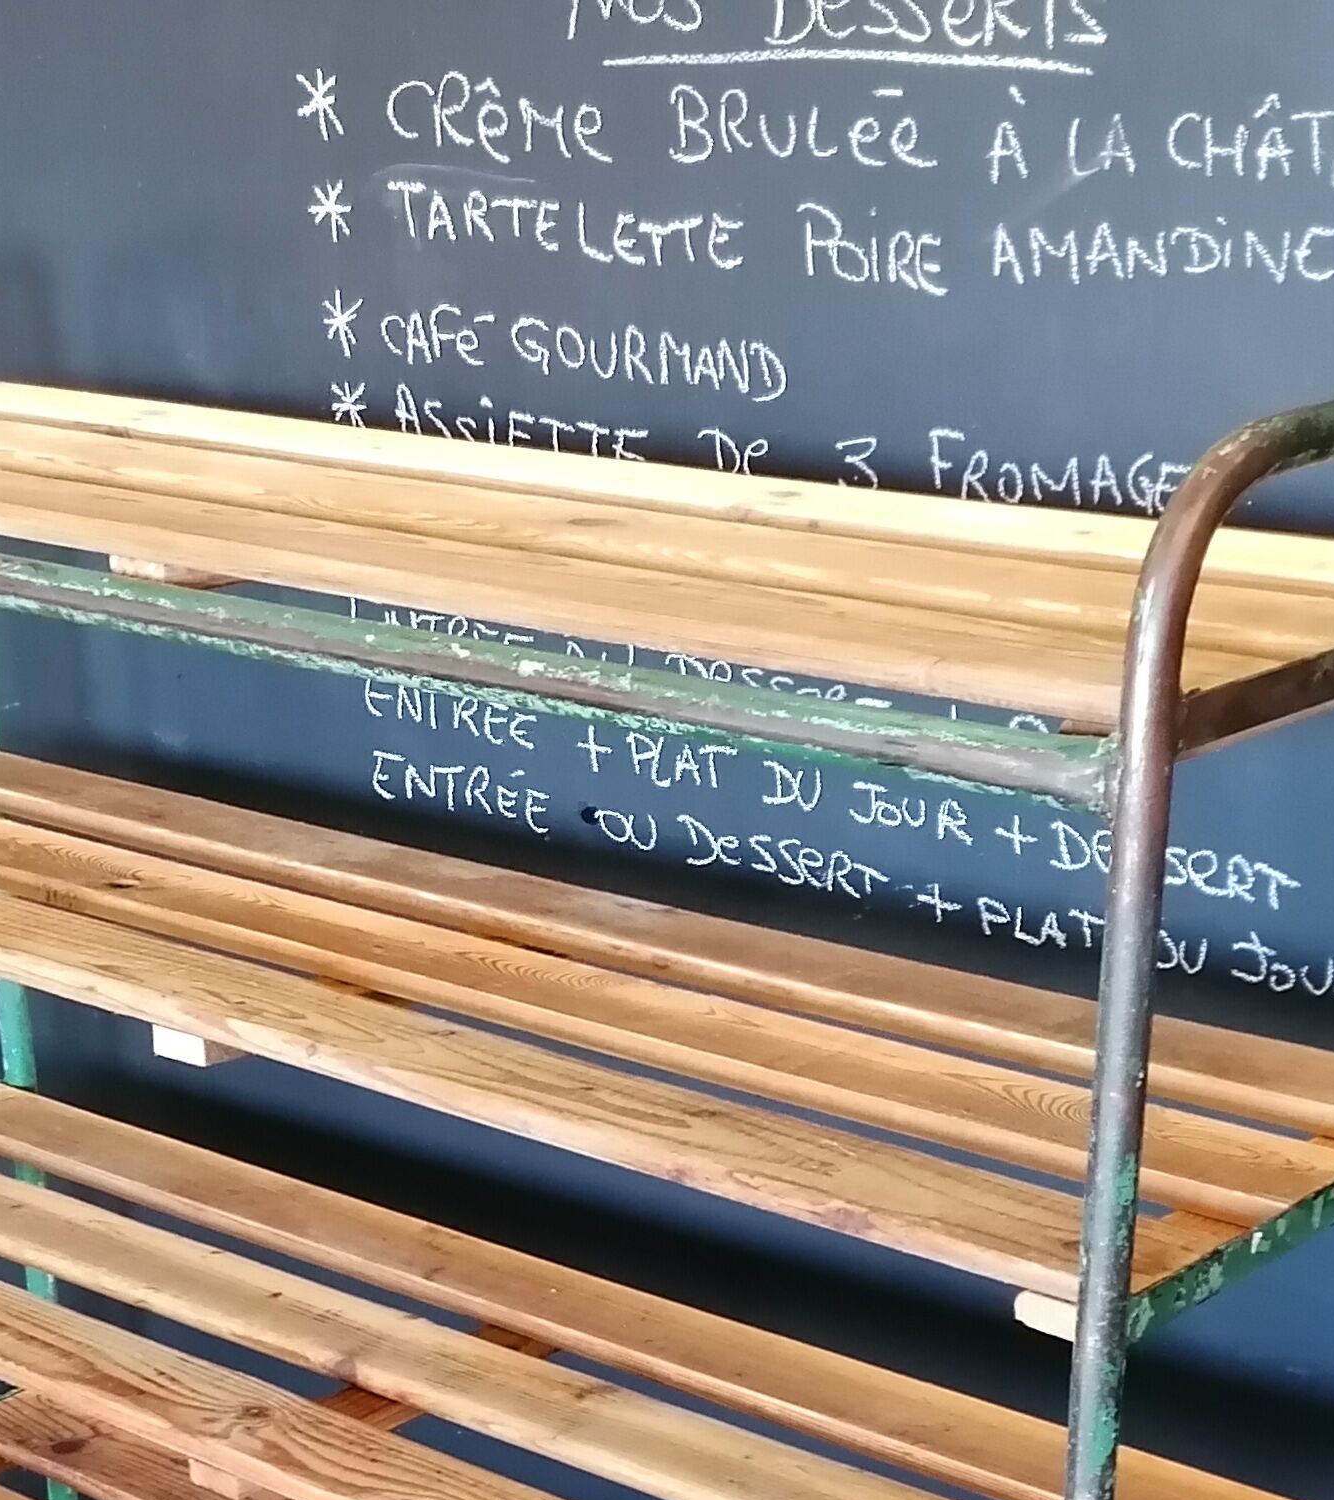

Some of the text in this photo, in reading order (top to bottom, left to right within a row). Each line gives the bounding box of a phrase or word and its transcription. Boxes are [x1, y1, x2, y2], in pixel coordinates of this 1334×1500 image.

[986, 85, 1028, 184] À
[1068, 113, 1136, 177] LA
[387, 180, 744, 271] TARTELETTE
[511, 316, 787, 403] GOURMAND
[577, 725, 613, 772] +
[627, 730, 739, 789] PLAT
[763, 760, 821, 811] DU
[850, 782, 972, 845] JOUR
[995, 815, 1038, 855] +
[372, 750, 550, 835] ENTRÉE
[597, 807, 657, 851] OU
[917, 882, 963, 923] +
[977, 896, 1105, 949] PLAT
